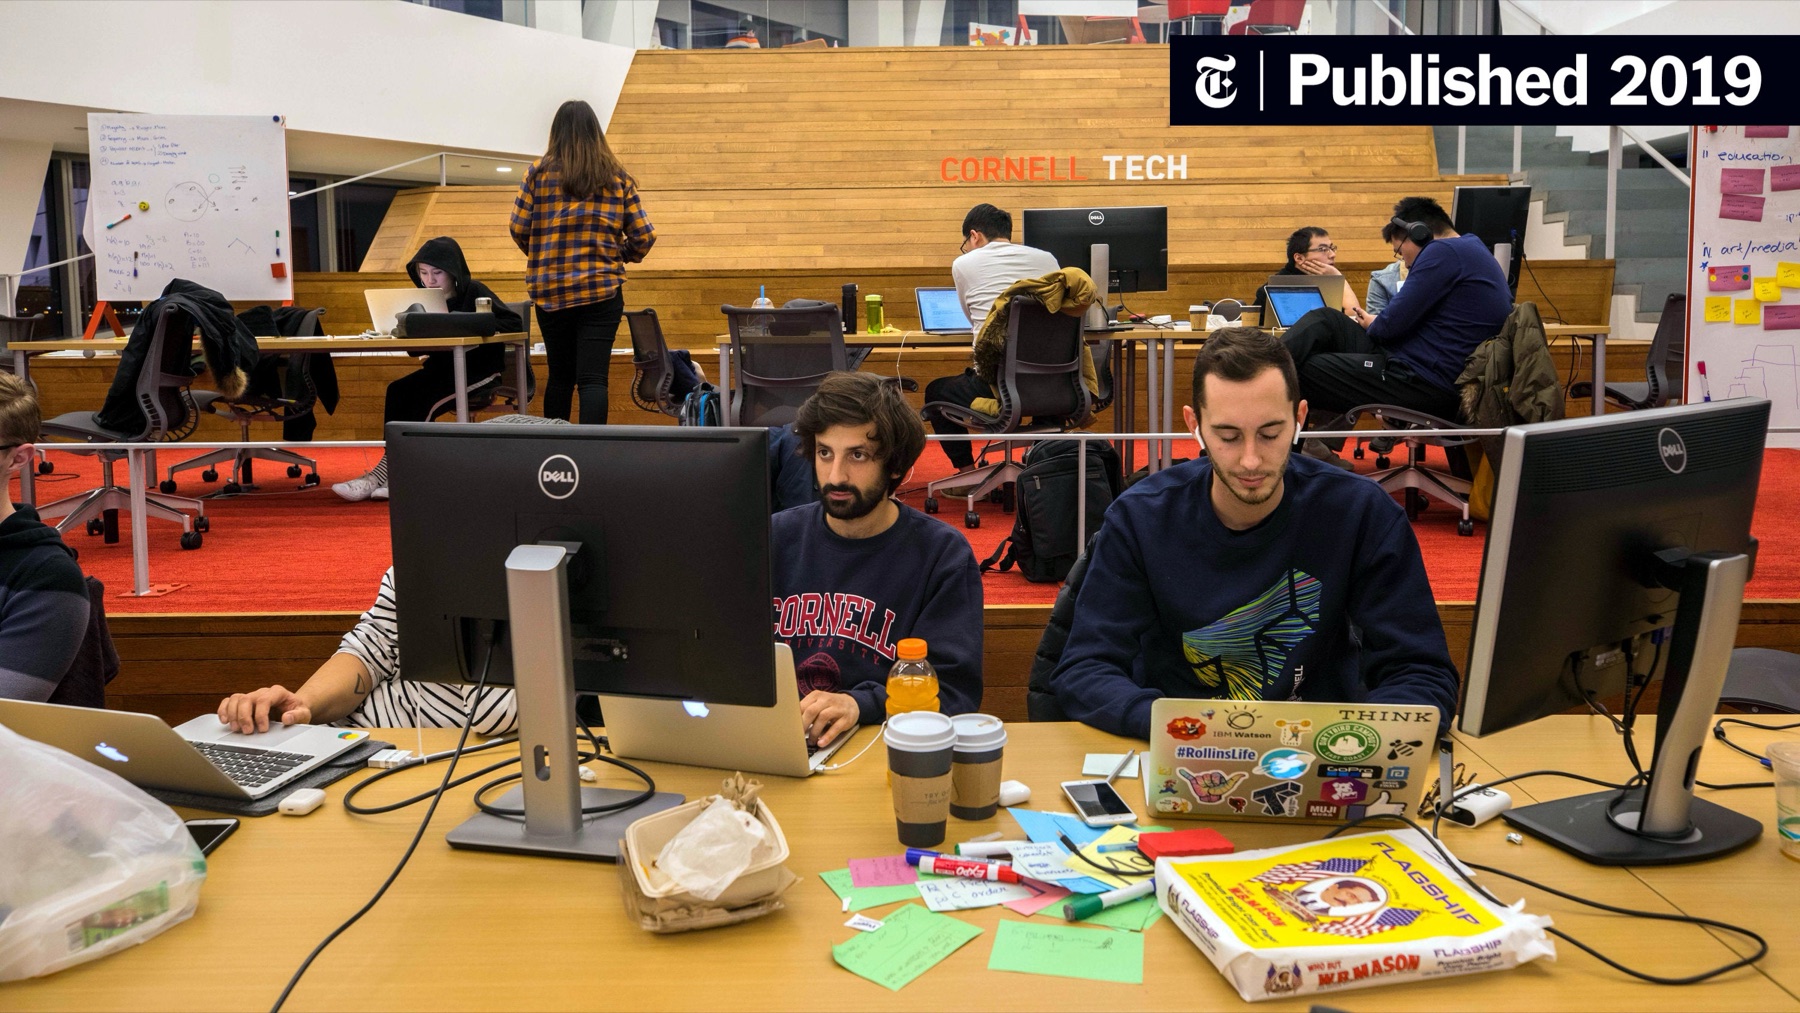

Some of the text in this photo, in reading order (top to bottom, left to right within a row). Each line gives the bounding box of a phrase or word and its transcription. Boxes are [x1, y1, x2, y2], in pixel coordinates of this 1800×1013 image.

[940, 155, 1188, 182] CORNELL TECH
[1661, 443, 1684, 457] DELL
[543, 470, 575, 483] DELL
[775, 638, 880, 665] NIVERSITY
[1338, 709, 1434, 722] THINK
[1234, 731, 1272, 739] Watson
[1176, 746, 1256, 760] #RollinsLife
[1309, 805, 1337, 814] MUJI
[955, 864, 986, 878] EXPO
[1371, 841, 1481, 925] FLAGSHIP
[1181, 899, 1219, 939] FLAGSHIP
[1433, 939, 1502, 958] FLAGSHIP
[1307, 961, 1342, 972] WHO BUT
